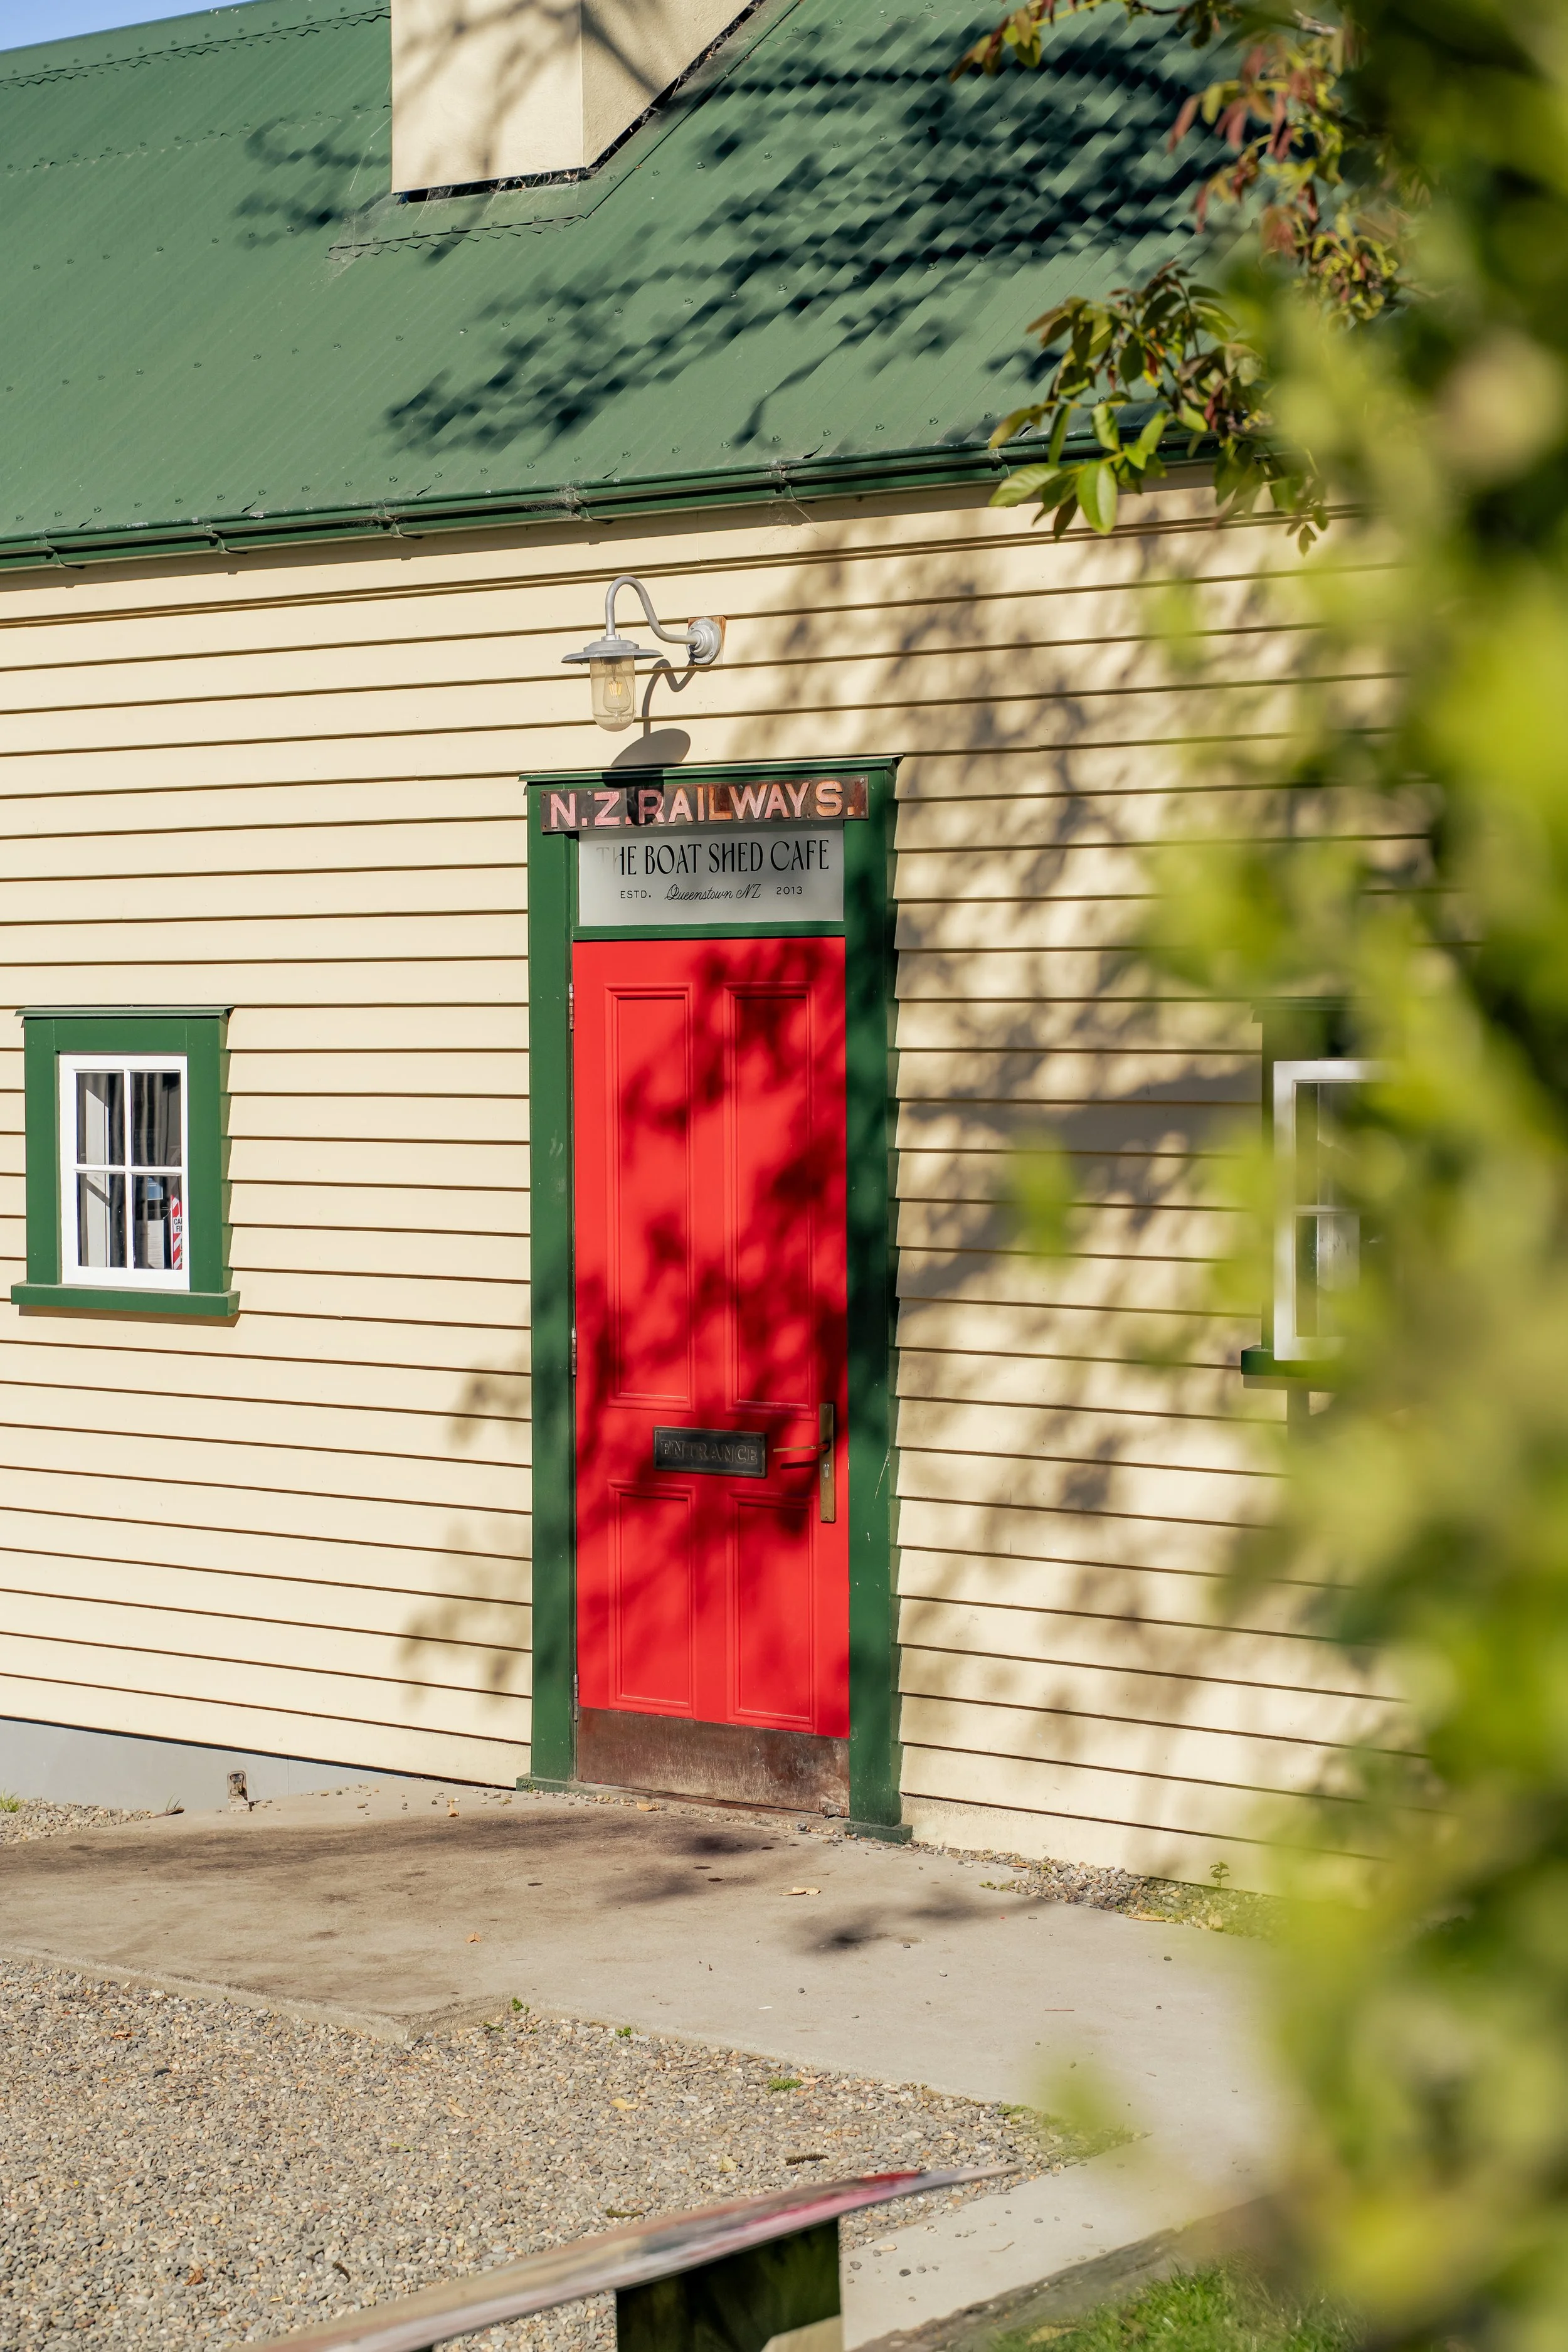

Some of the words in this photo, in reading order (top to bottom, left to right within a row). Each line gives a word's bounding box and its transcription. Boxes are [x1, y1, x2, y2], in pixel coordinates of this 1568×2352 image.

[645, 844, 702, 875] BOAT
[708, 841, 764, 873] SHED
[770, 839, 830, 871] CAFE
[620, 889, 652, 899] ESTD.
[664, 883, 734, 901] Queenstown
[735, 882, 762, 899] NZ
[775, 886, 803, 895] 2013
[660, 1439, 758, 1465] ENTRANCE
